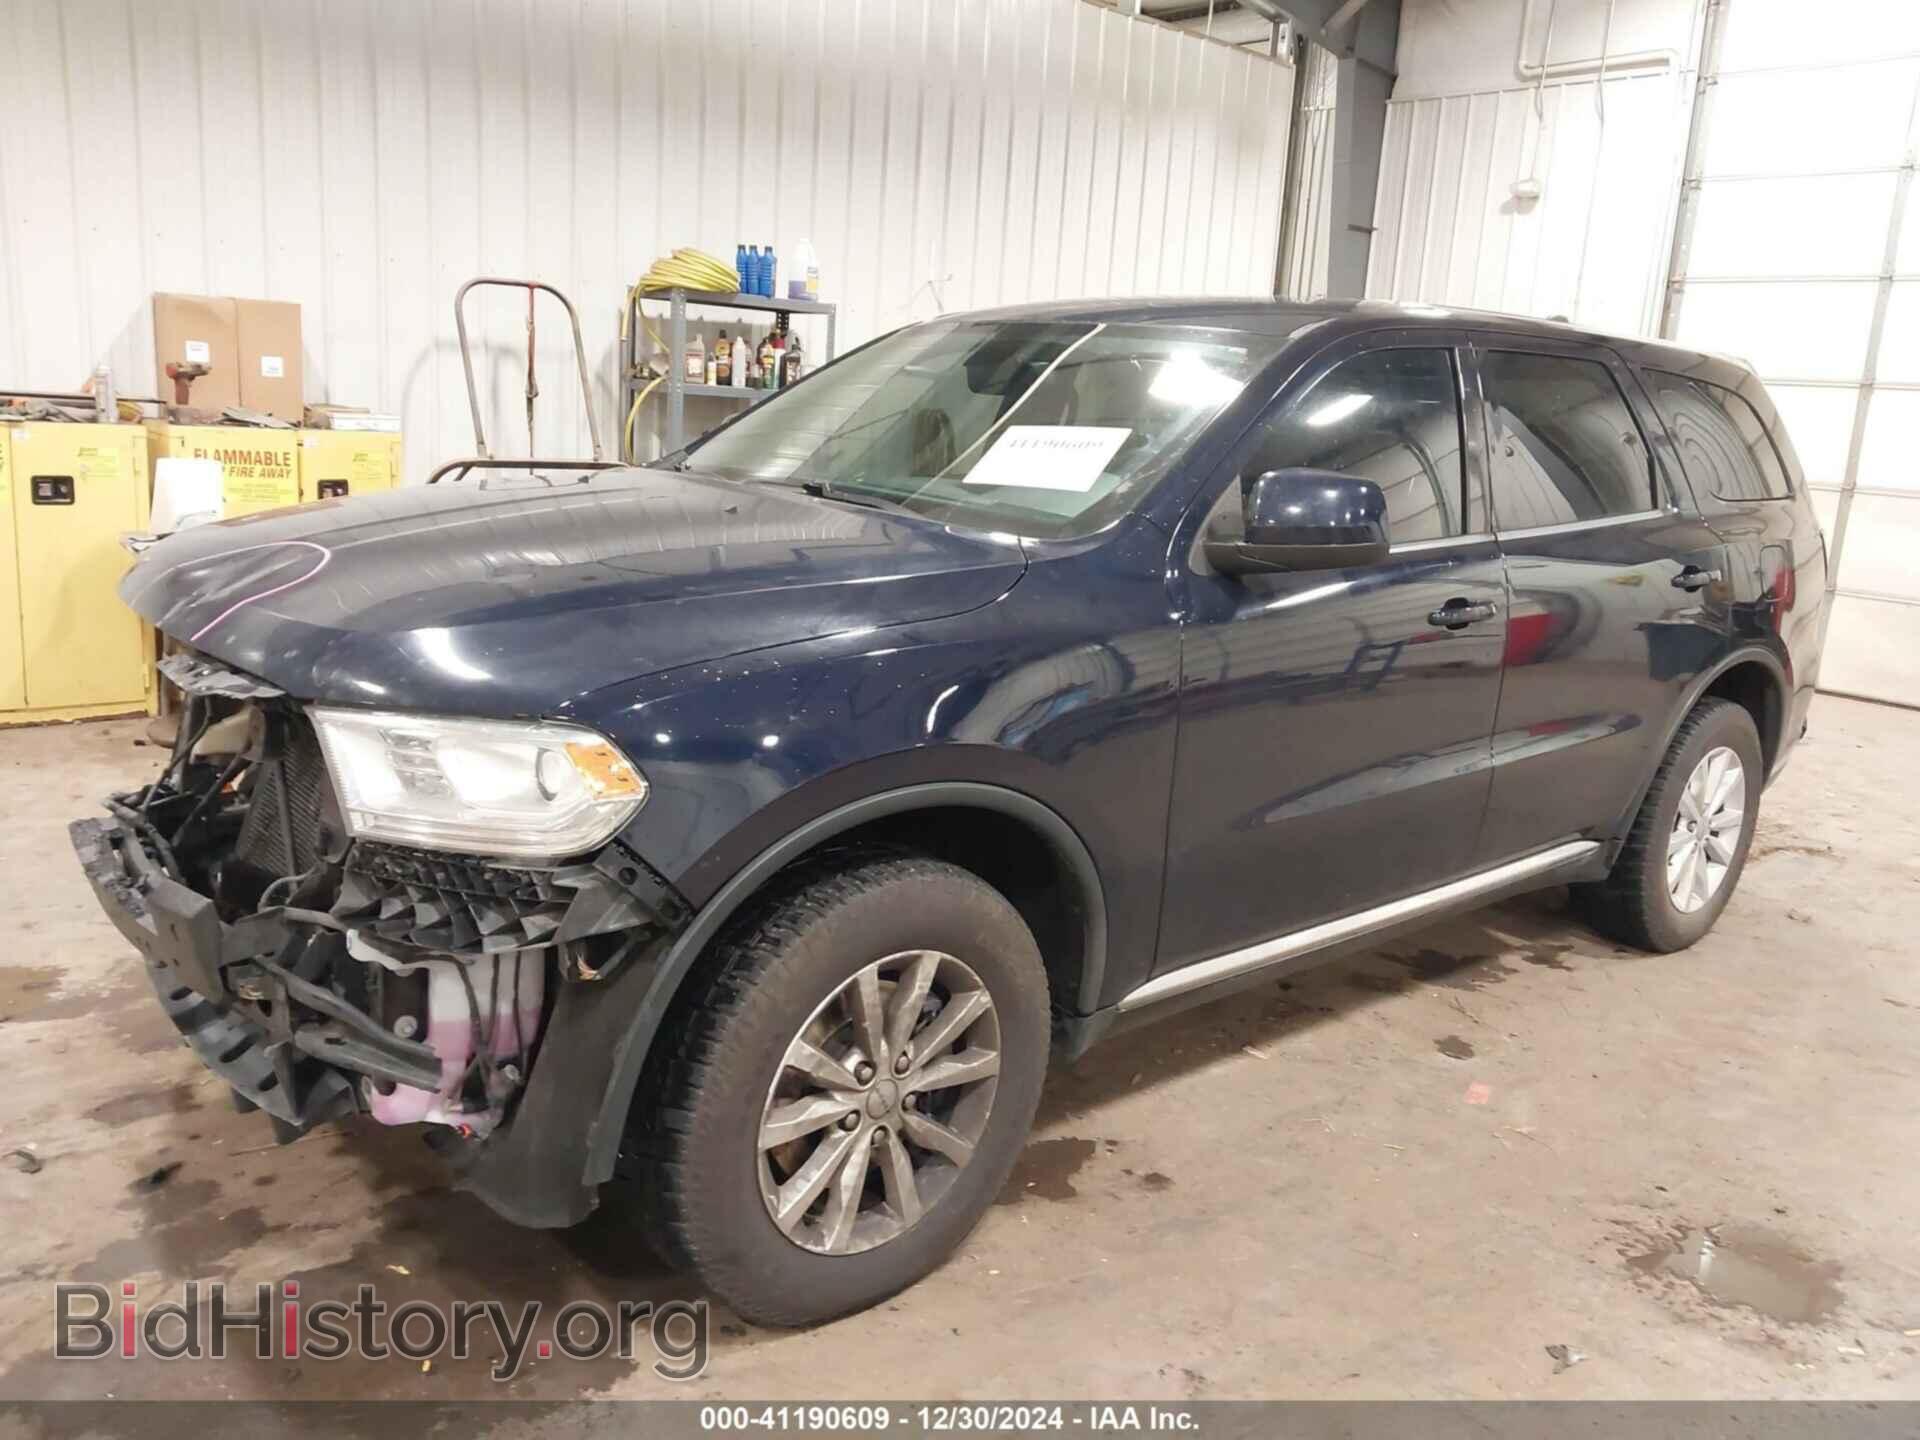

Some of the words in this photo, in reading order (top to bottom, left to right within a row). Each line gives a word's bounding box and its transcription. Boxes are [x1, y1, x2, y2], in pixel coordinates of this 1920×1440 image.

[194, 449, 291, 466] FLAMMABLE
[229, 466, 255, 478] FIRE
[259, 467, 292, 479] AWAY
